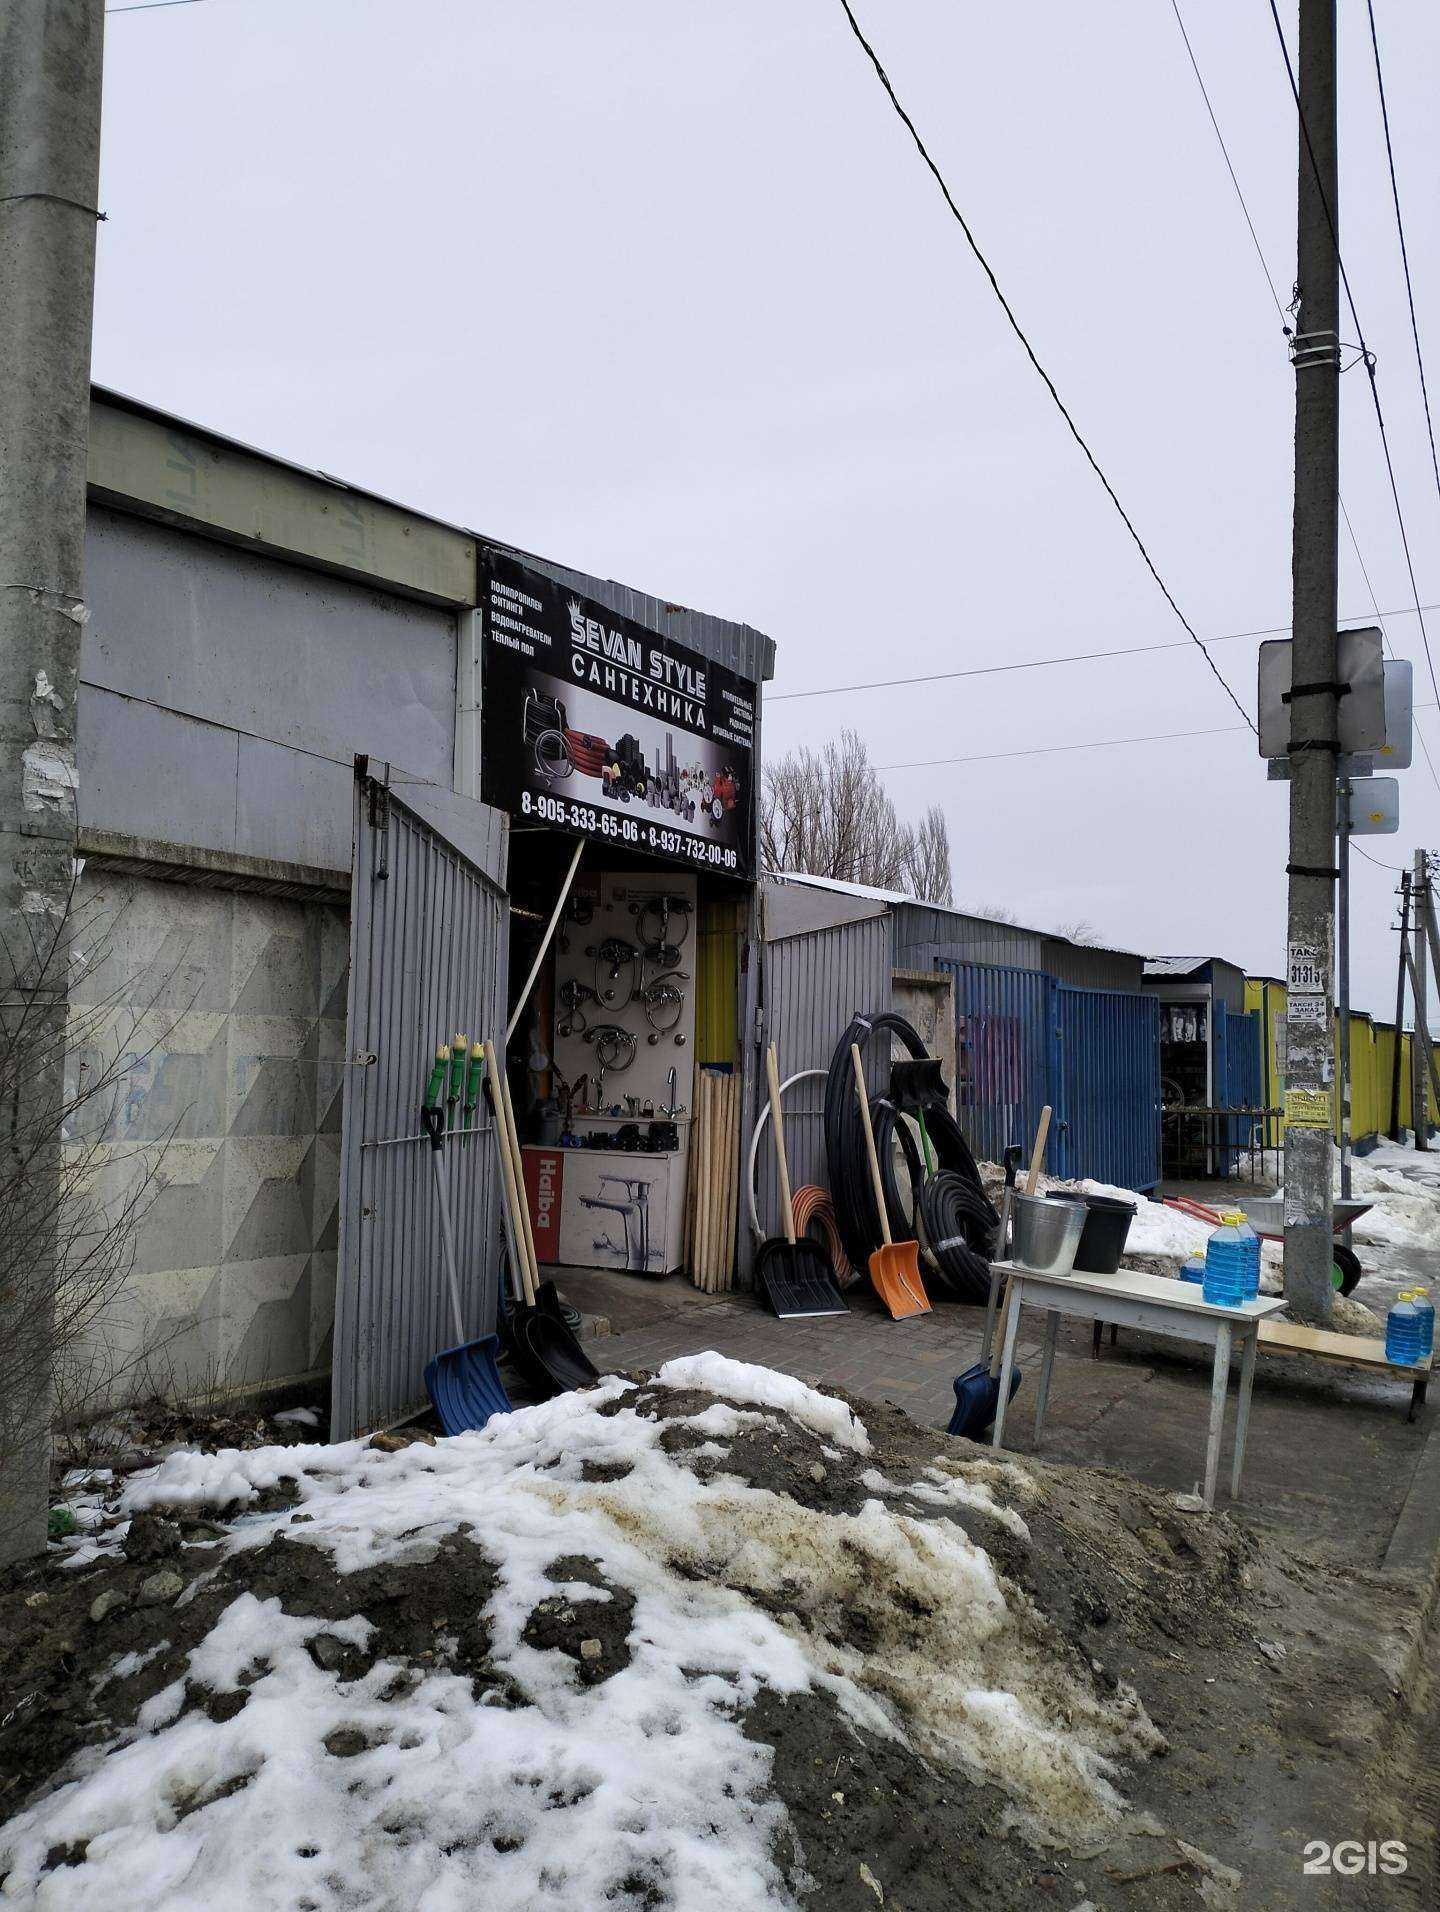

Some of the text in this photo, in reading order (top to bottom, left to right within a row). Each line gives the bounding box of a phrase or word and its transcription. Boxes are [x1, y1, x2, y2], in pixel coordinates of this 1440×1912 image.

[491, 580, 542, 612] ПОЛИПРОПИЛЕН
[491, 594, 523, 616] ФИТИНГИ
[491, 611, 552, 646] ВОДОНАГРЕВАТЕЛИ
[521, 642, 535, 656] ПОЛ
[570, 613, 706, 700] SEVAN STYLE
[571, 653, 706, 730] САНТЕХНИКА
[521, 791, 737, 869] 8-905-333-65-06 8-937-732-00-06
[537, 1159, 558, 1228] Haiba
